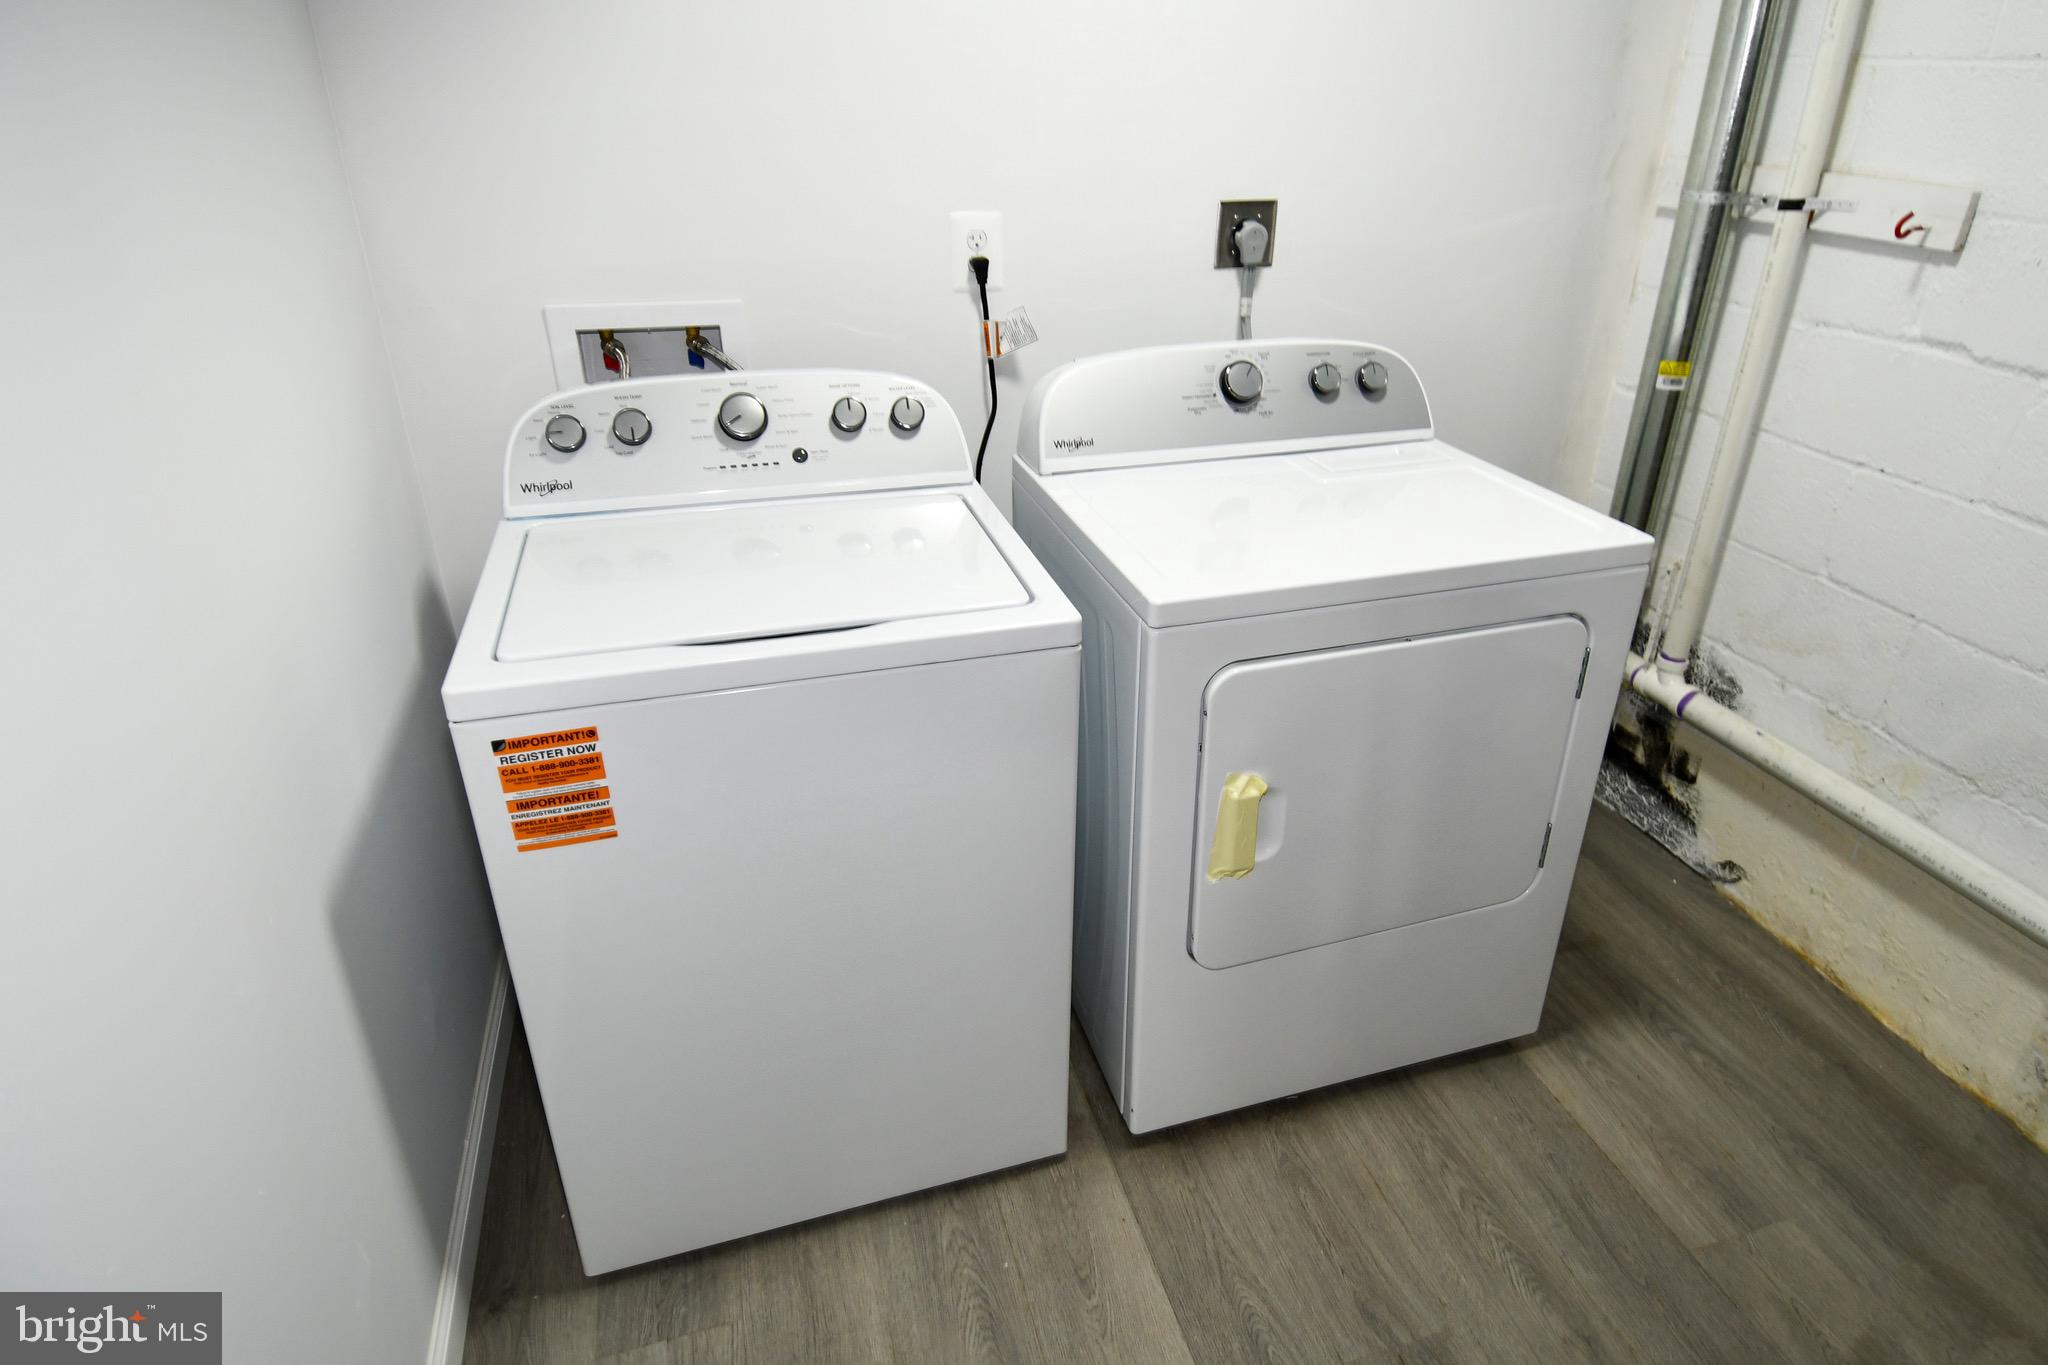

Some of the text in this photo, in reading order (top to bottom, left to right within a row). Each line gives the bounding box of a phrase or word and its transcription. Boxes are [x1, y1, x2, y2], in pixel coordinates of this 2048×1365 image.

[1053, 437, 1094, 452] Whirlpool
[520, 479, 573, 497] Whirlpool
[508, 730, 585, 750] IMPORTANT!
[500, 743, 597, 766] REGISTER NOW
[501, 767, 529, 777] CALL
[511, 800, 611, 820] ENREGISTREZ MAINTENANT
[516, 790, 599, 811] IMPORTANTE!
[514, 818, 548, 828] APPELEZ
